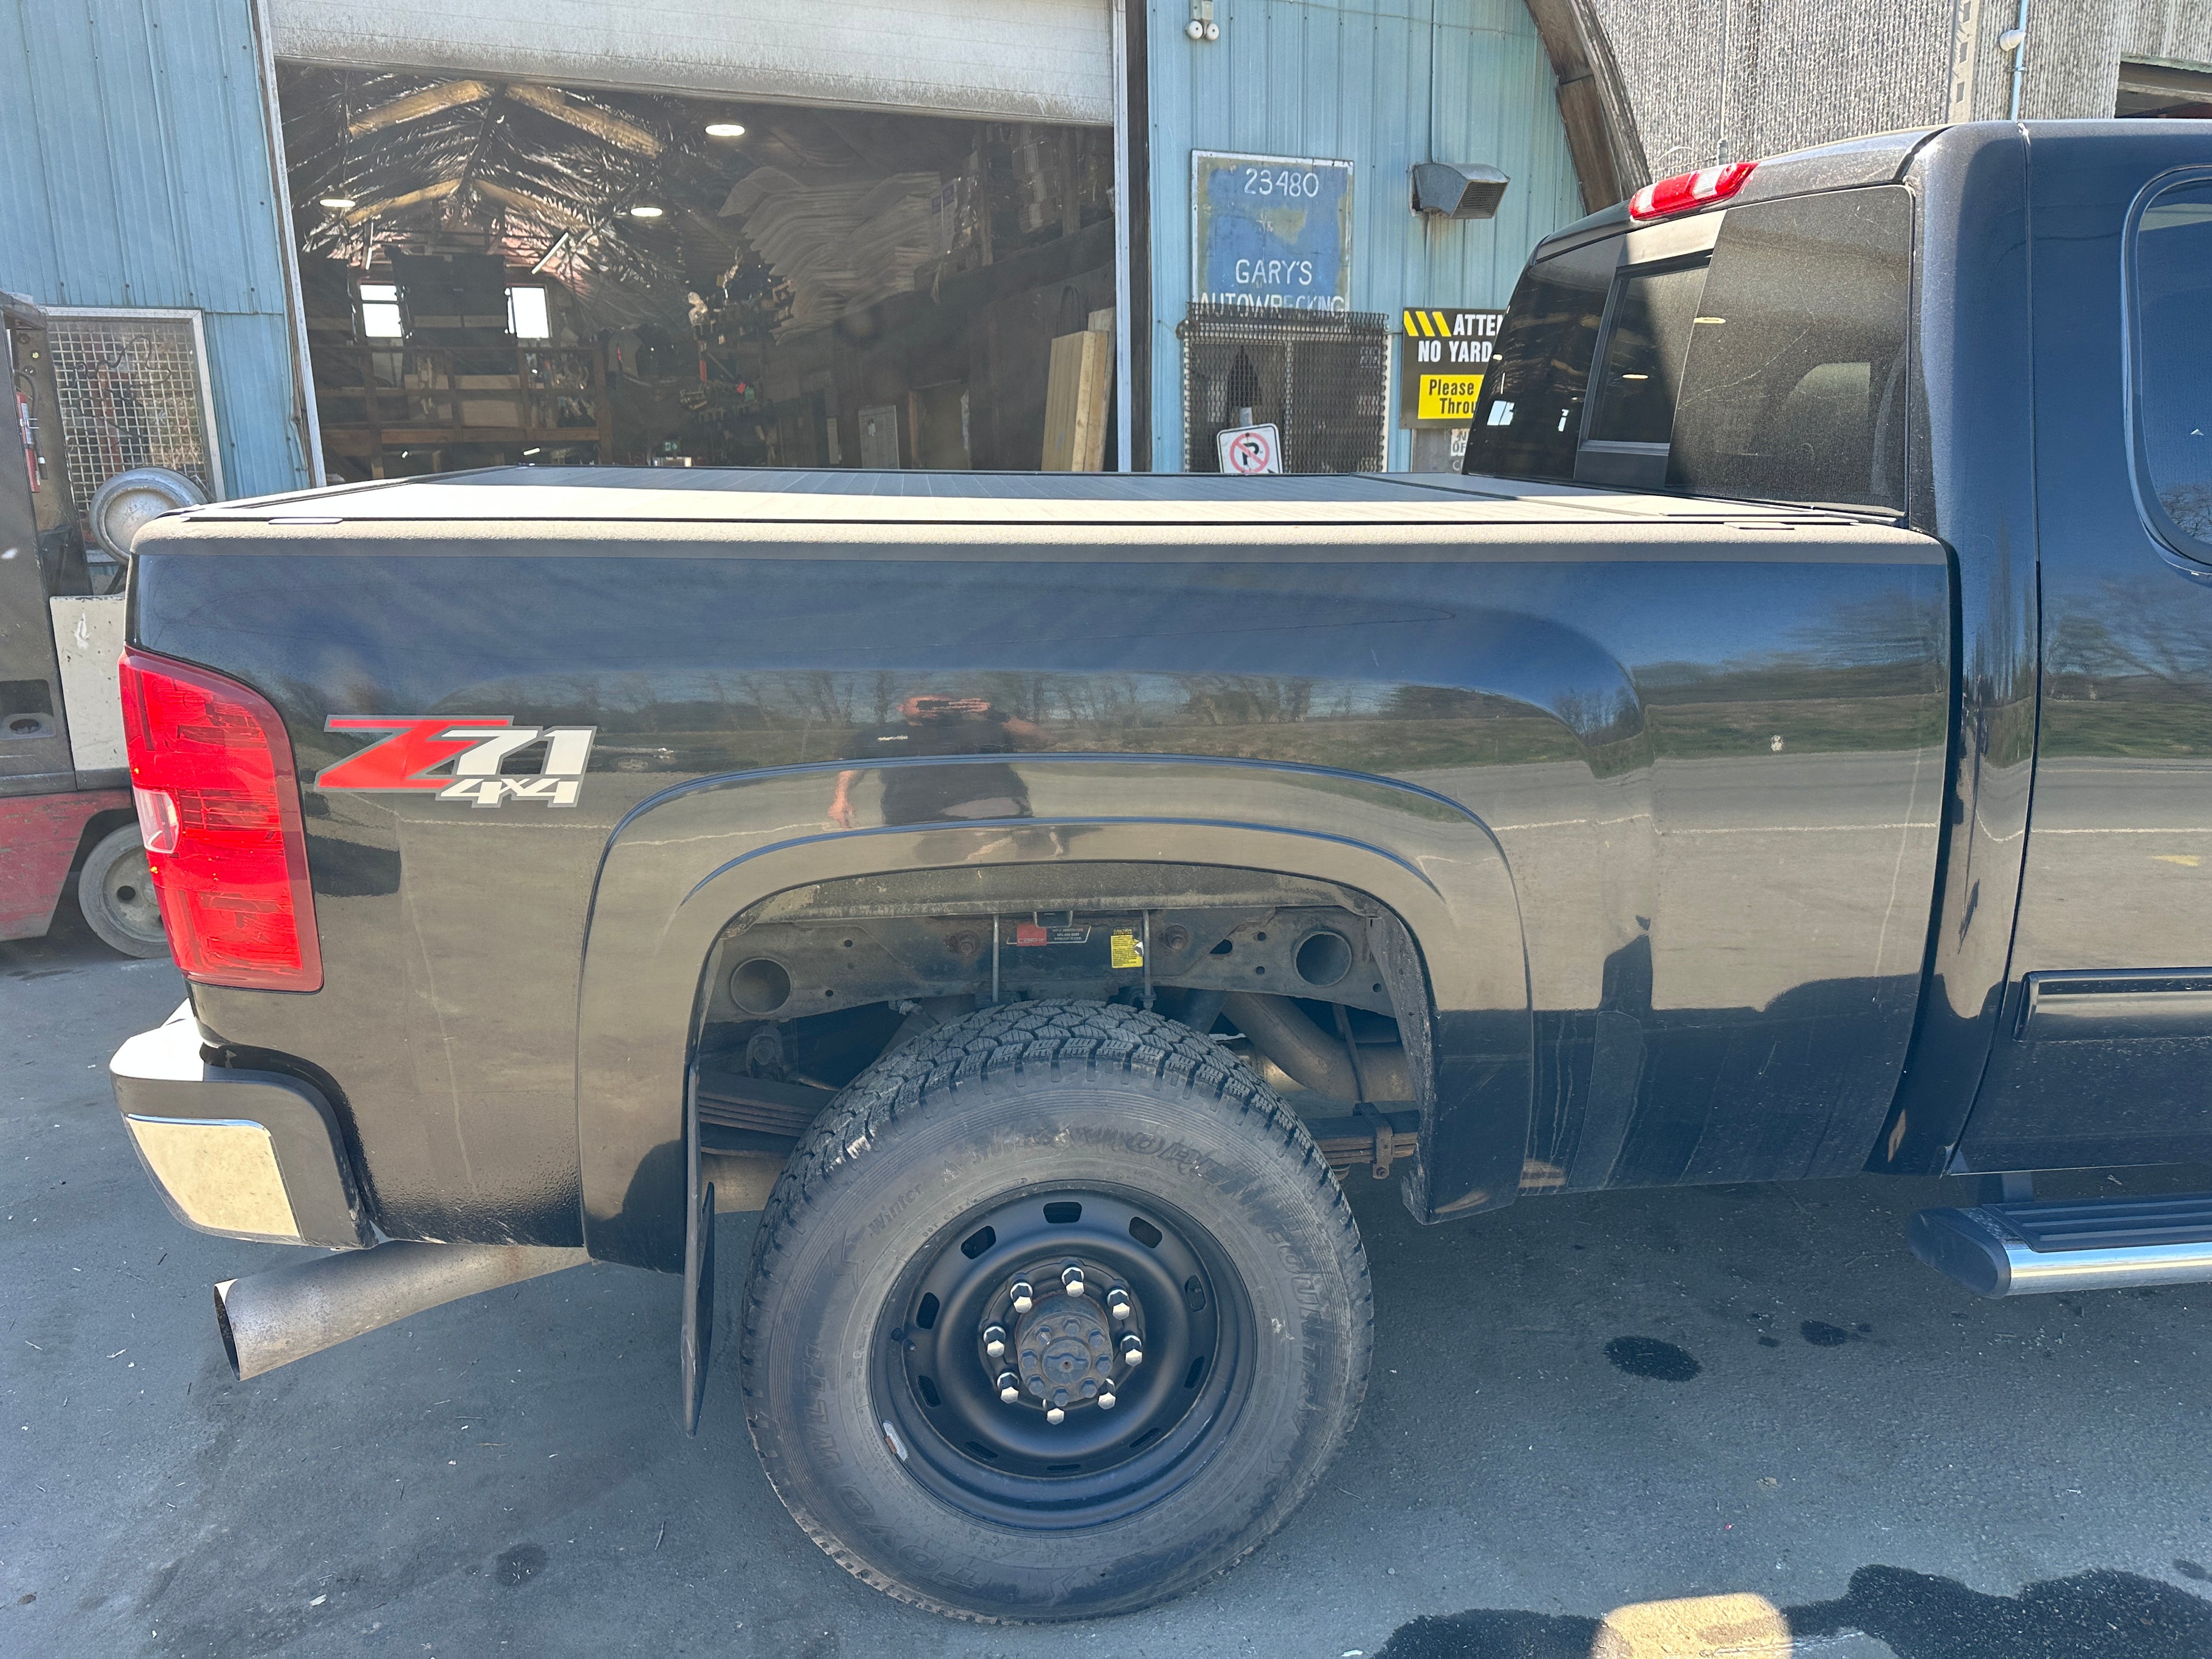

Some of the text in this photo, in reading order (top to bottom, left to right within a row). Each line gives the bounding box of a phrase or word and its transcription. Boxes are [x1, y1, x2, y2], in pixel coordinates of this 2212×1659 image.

[1244, 168, 1319, 198] 23480
[1235, 259, 1313, 285] GARY'S
[1418, 340, 1492, 362] NO YARD
[1429, 378, 1474, 396] Please
[315, 715, 596, 791] Z71
[867, 1183, 922, 1237] Winter
[836, 1485, 978, 1589] TOYO
